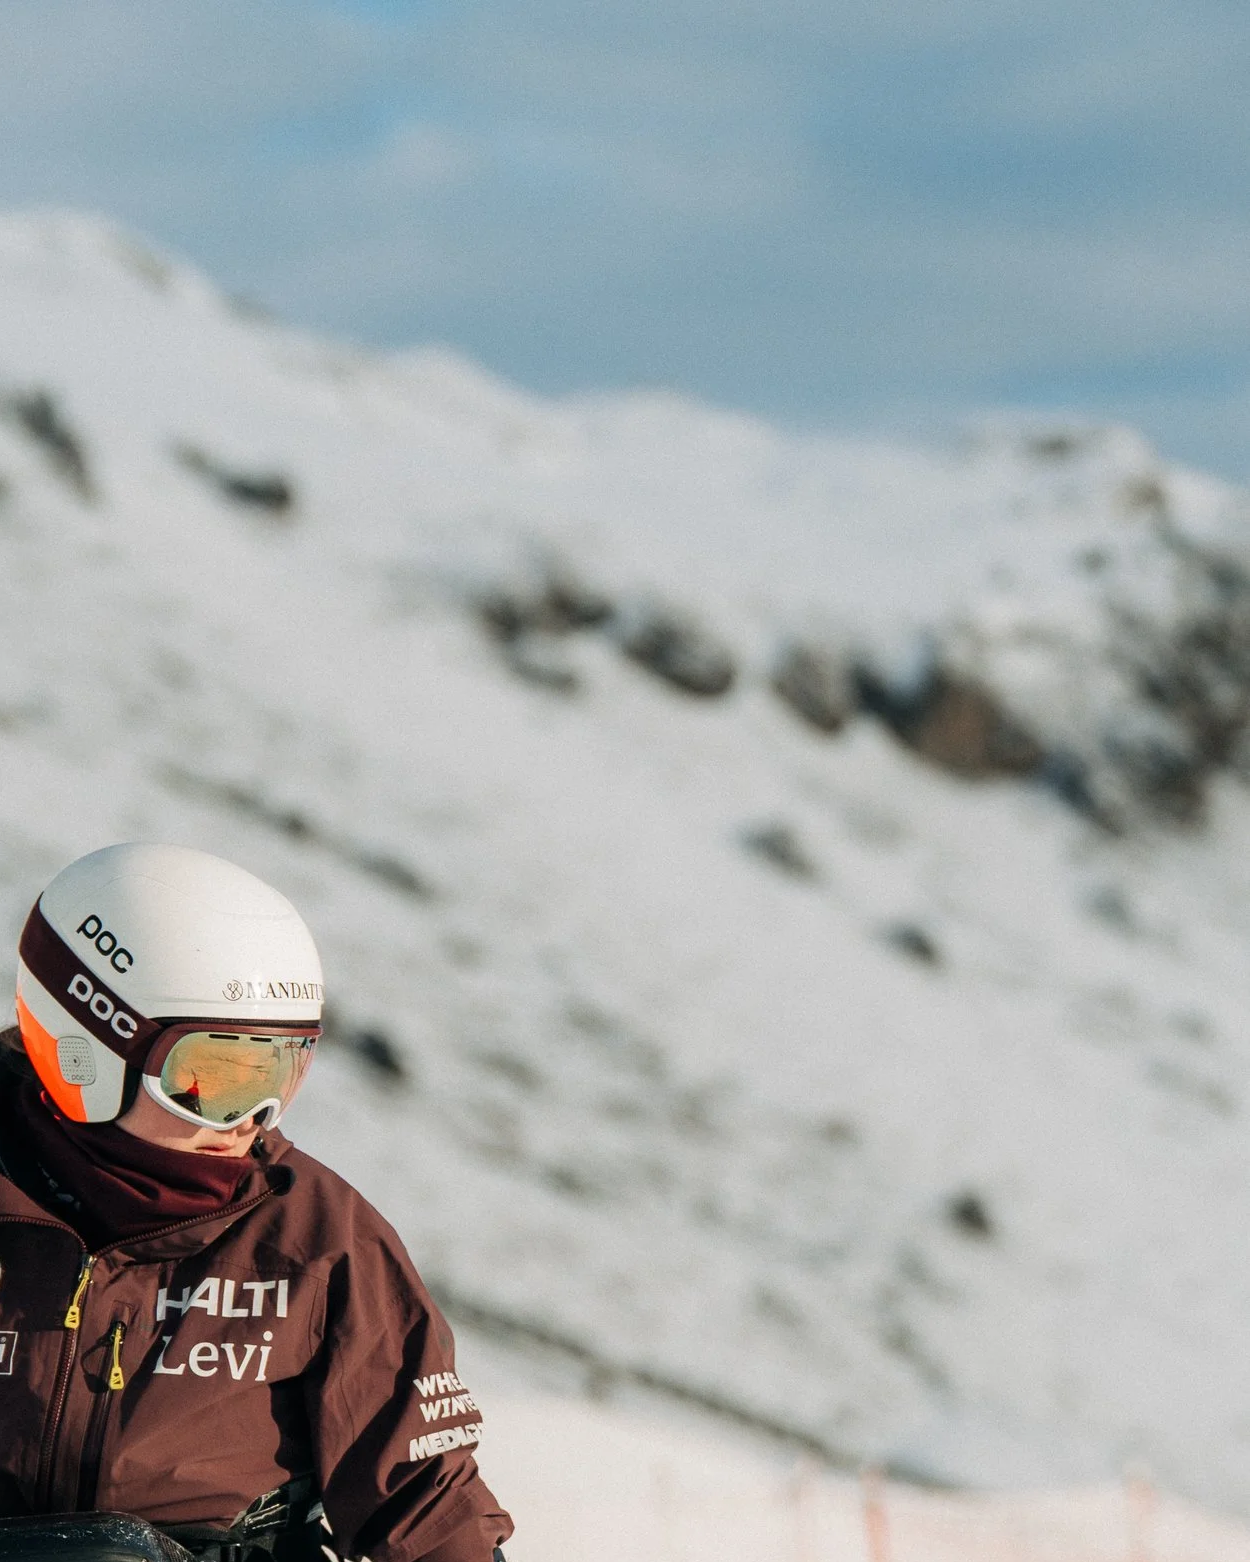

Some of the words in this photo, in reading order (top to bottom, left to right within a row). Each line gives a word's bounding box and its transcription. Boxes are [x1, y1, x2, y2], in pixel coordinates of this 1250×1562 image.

[246, 982, 323, 1001] MANDATU
[156, 1277, 288, 1322] HALTI
[152, 1330, 273, 1382] Levi
[413, 1371, 466, 1398] WHE
